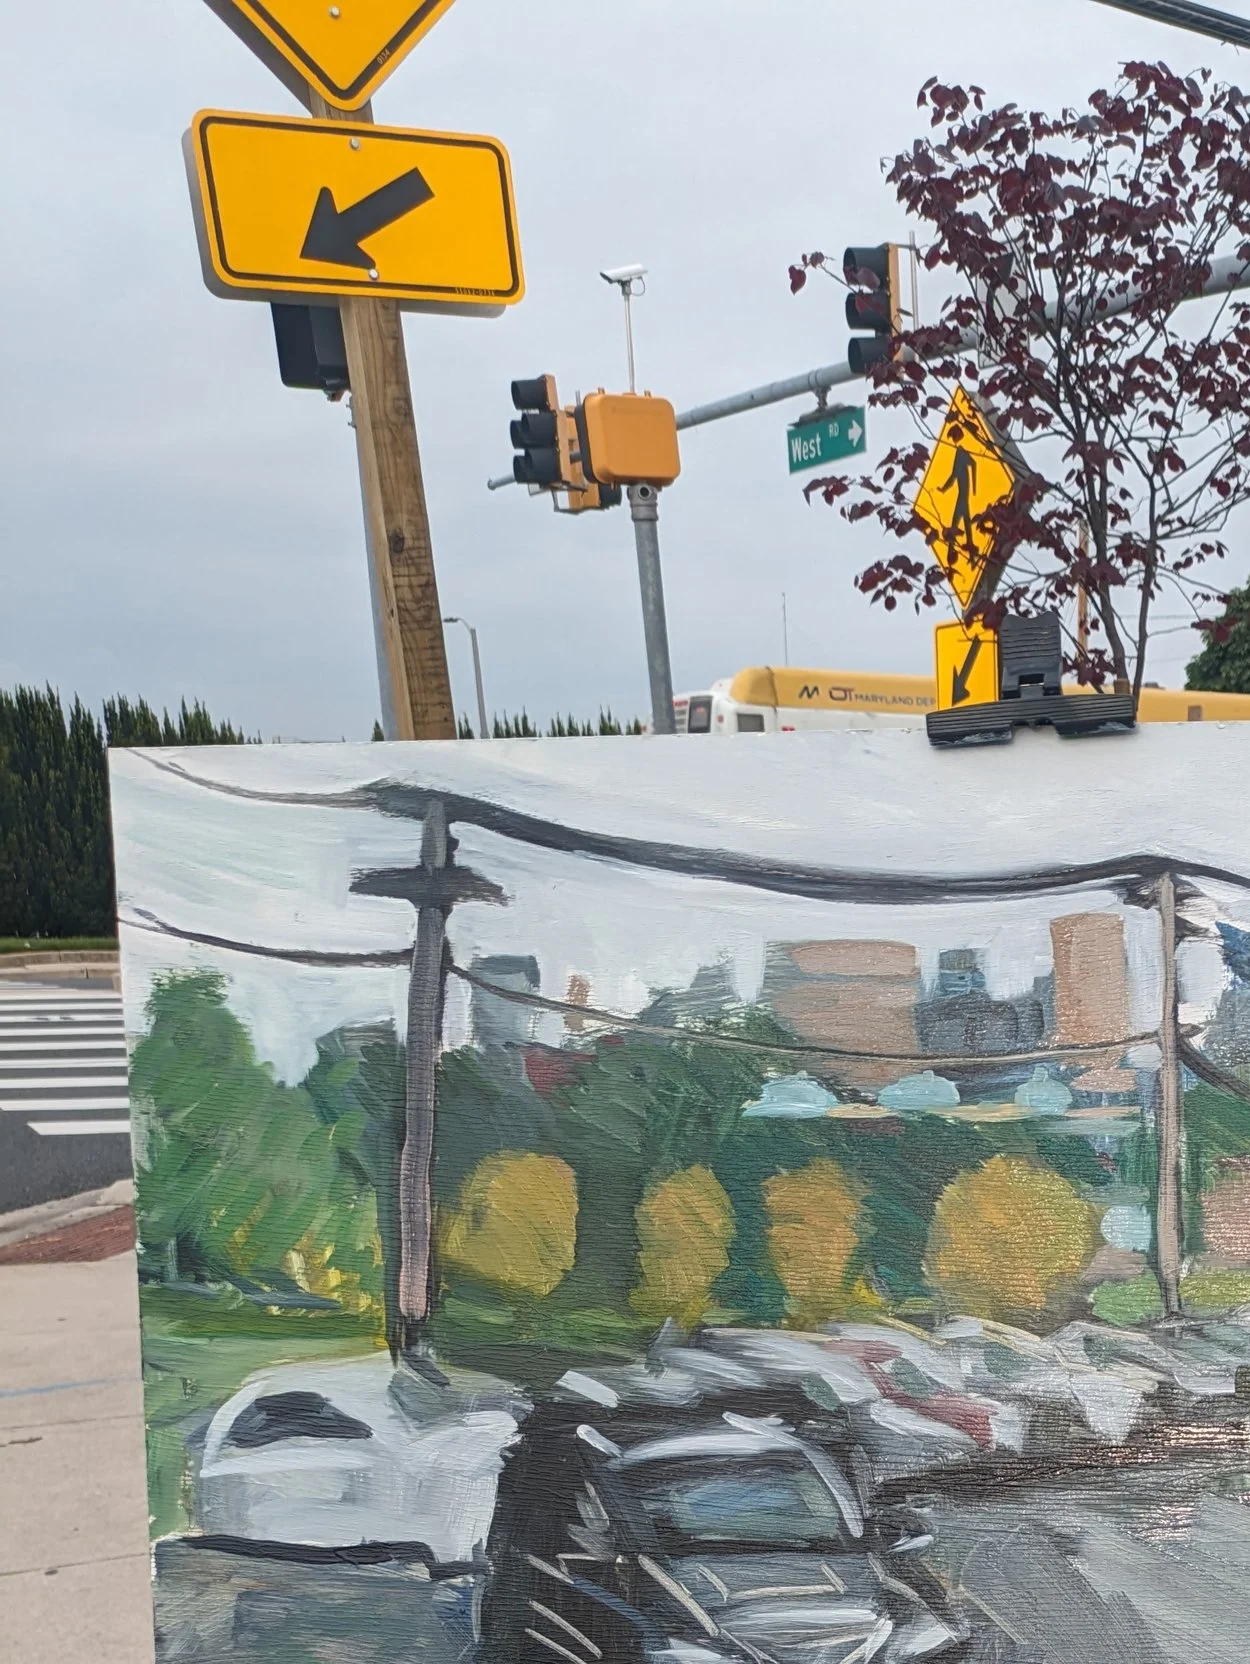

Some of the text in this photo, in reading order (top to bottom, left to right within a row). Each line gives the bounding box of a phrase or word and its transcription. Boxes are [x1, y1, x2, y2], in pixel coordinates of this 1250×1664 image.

[791, 423, 840, 464] West RD
[855, 693, 913, 705] MARYLAND
